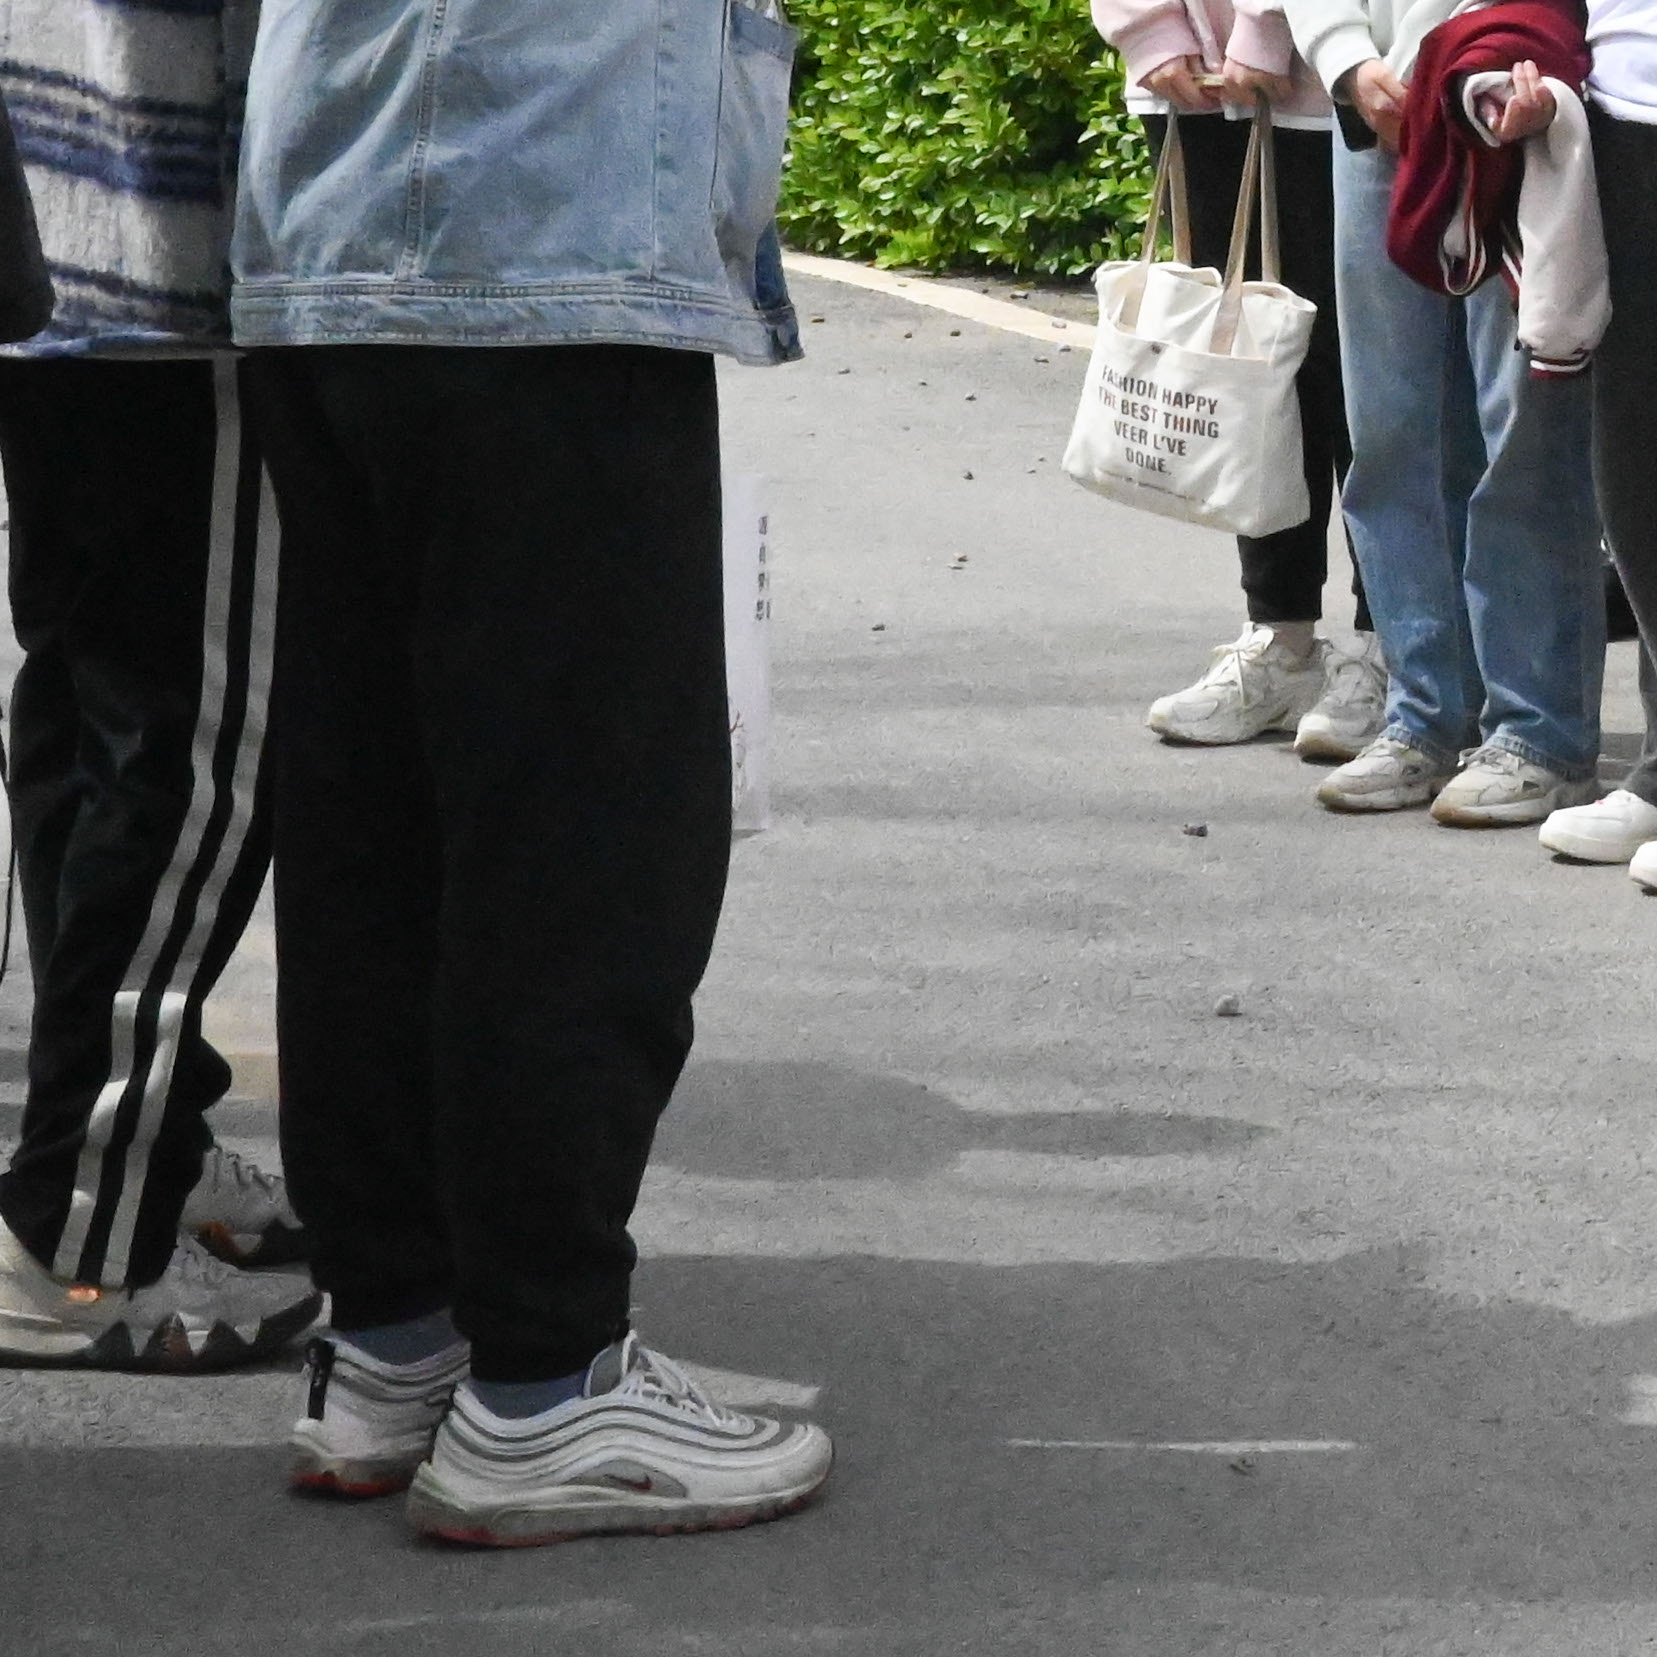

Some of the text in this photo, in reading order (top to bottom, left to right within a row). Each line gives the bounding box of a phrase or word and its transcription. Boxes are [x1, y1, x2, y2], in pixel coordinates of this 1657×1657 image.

[1162, 387, 1219, 416] HAPPY
[1113, 420, 1149, 446] VEER
[1120, 399, 1159, 424] BEST
[1162, 411, 1220, 439] THING
